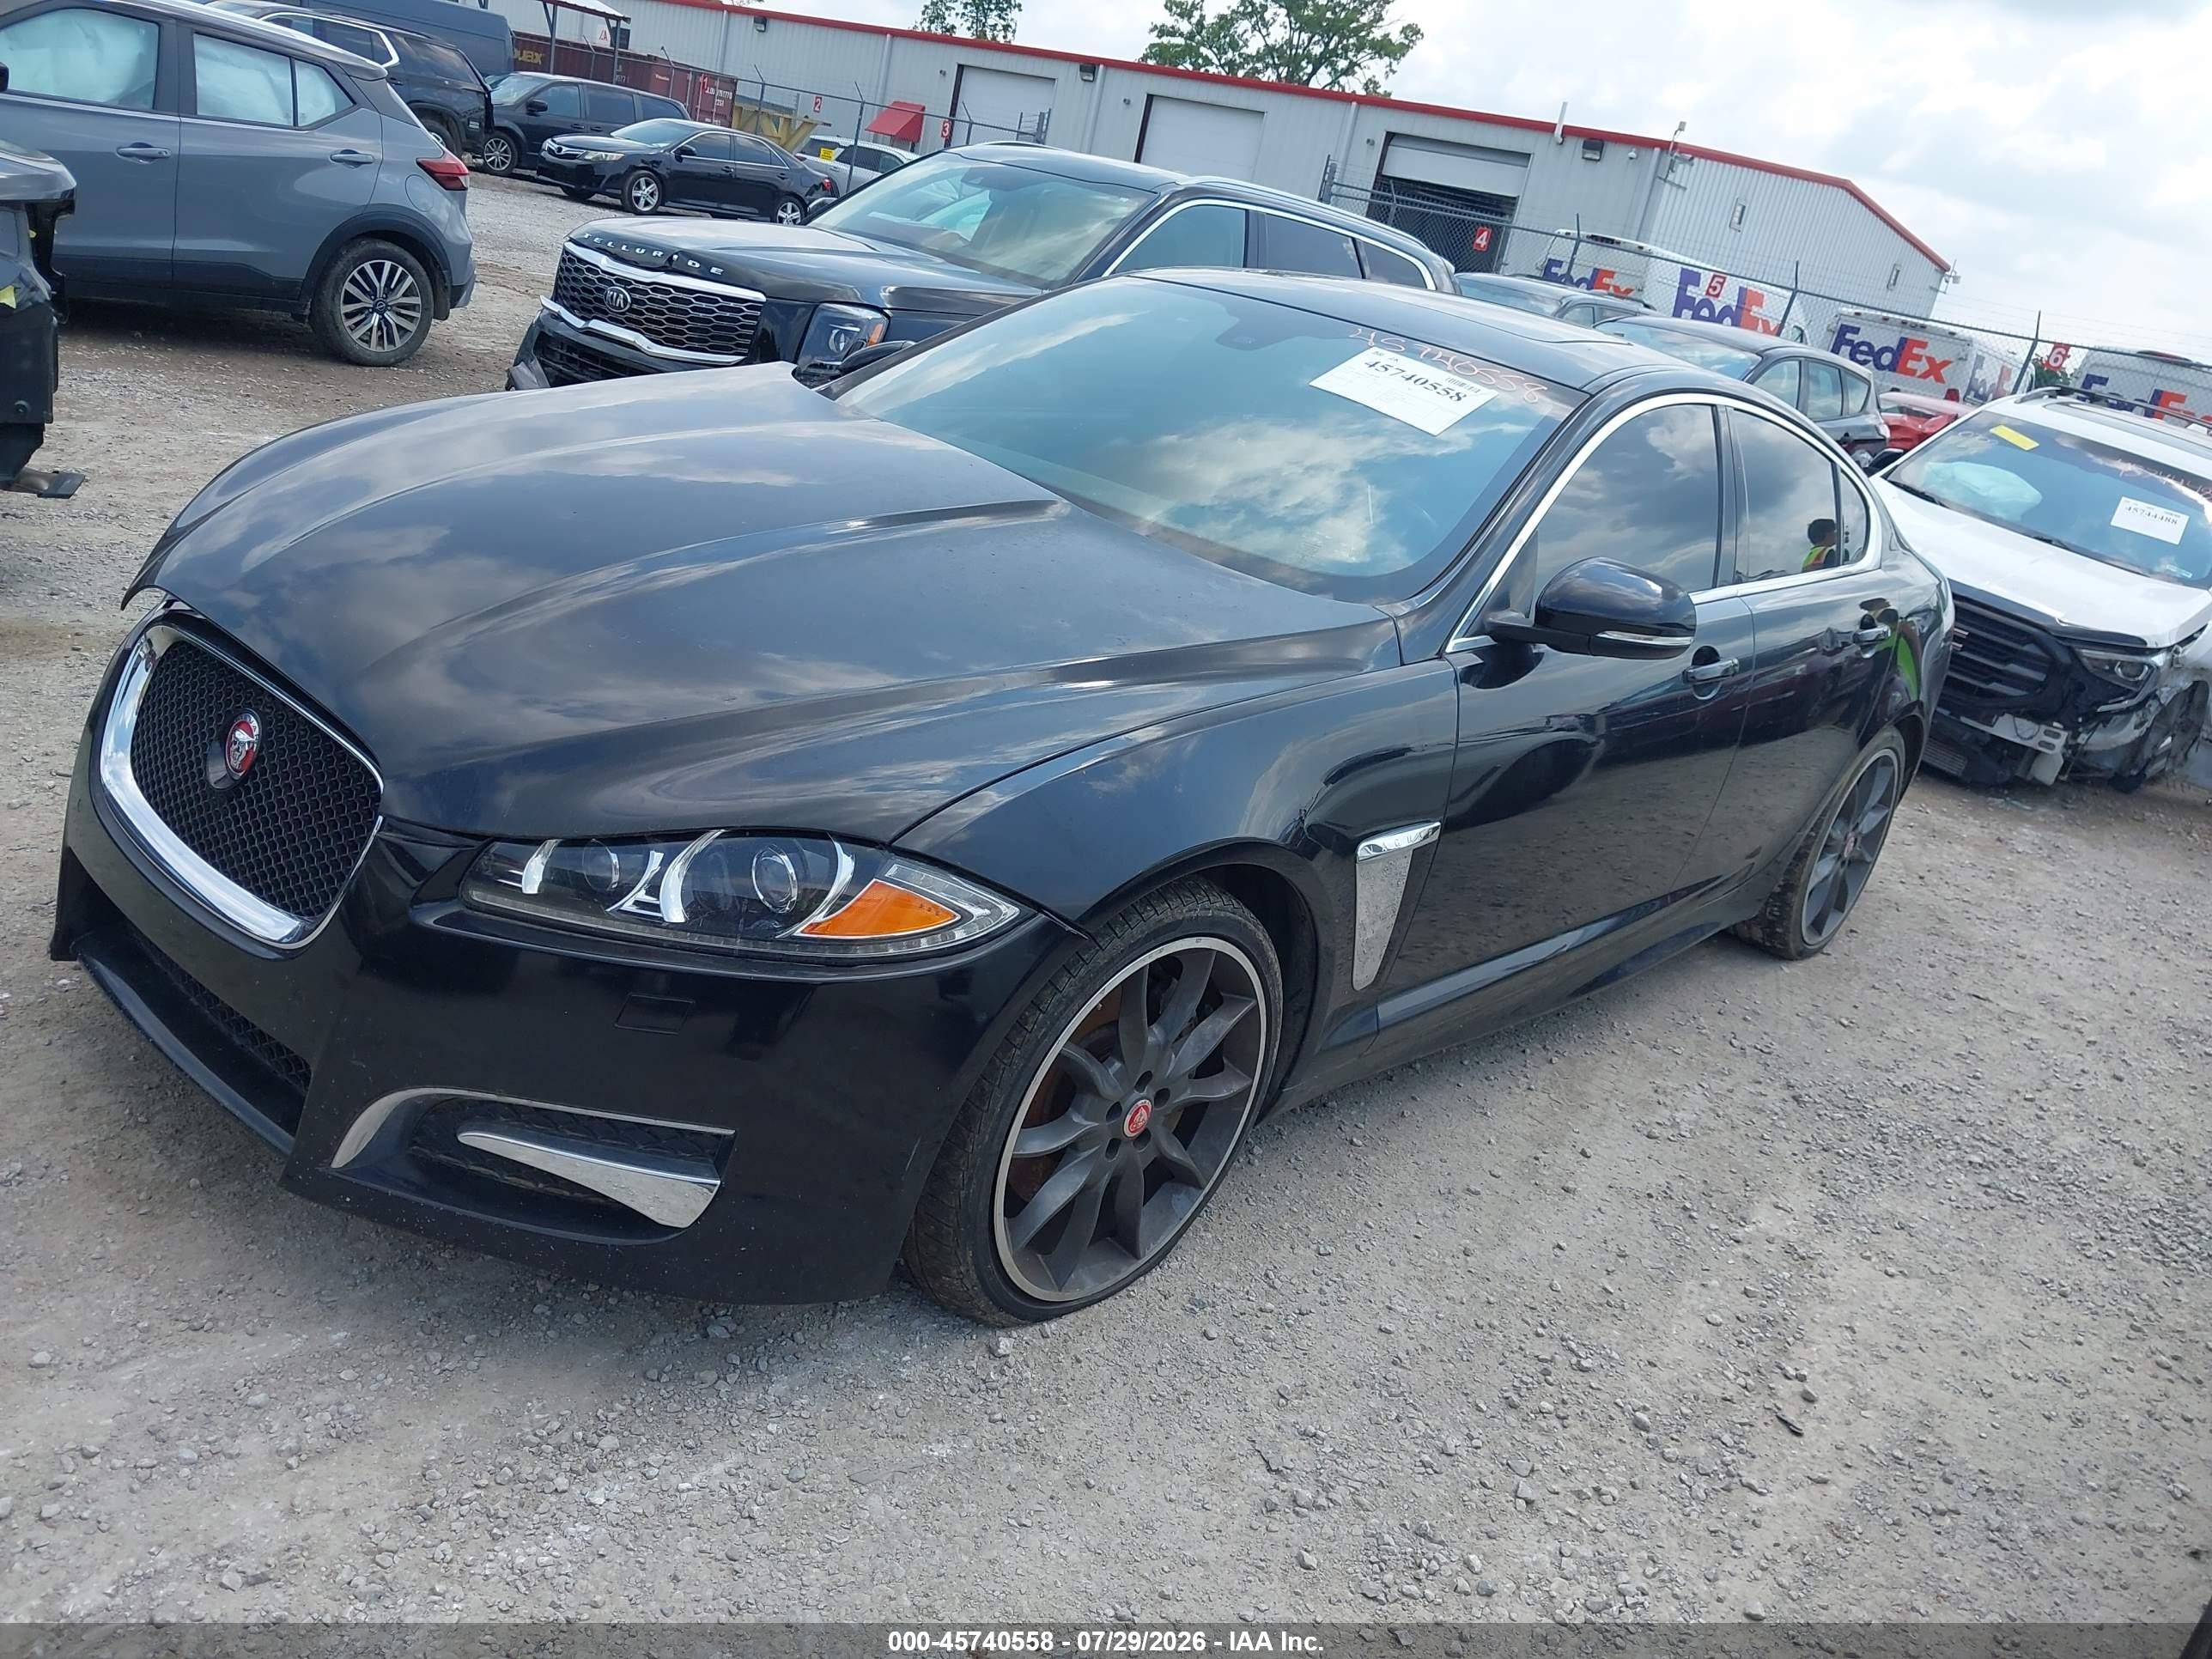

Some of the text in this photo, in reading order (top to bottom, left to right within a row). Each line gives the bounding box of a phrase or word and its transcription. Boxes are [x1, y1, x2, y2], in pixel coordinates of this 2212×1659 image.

[583, 233, 725, 276] TELLURIDE
[1475, 230, 1489, 248] 4
[605, 289, 626, 310] KIA
[1708, 276, 1723, 295] 5
[1349, 328, 1547, 404] 45740558
[1831, 323, 1954, 385] FedEx
[2048, 348, 2066, 367] 6
[1364, 359, 1468, 403] 45740558
